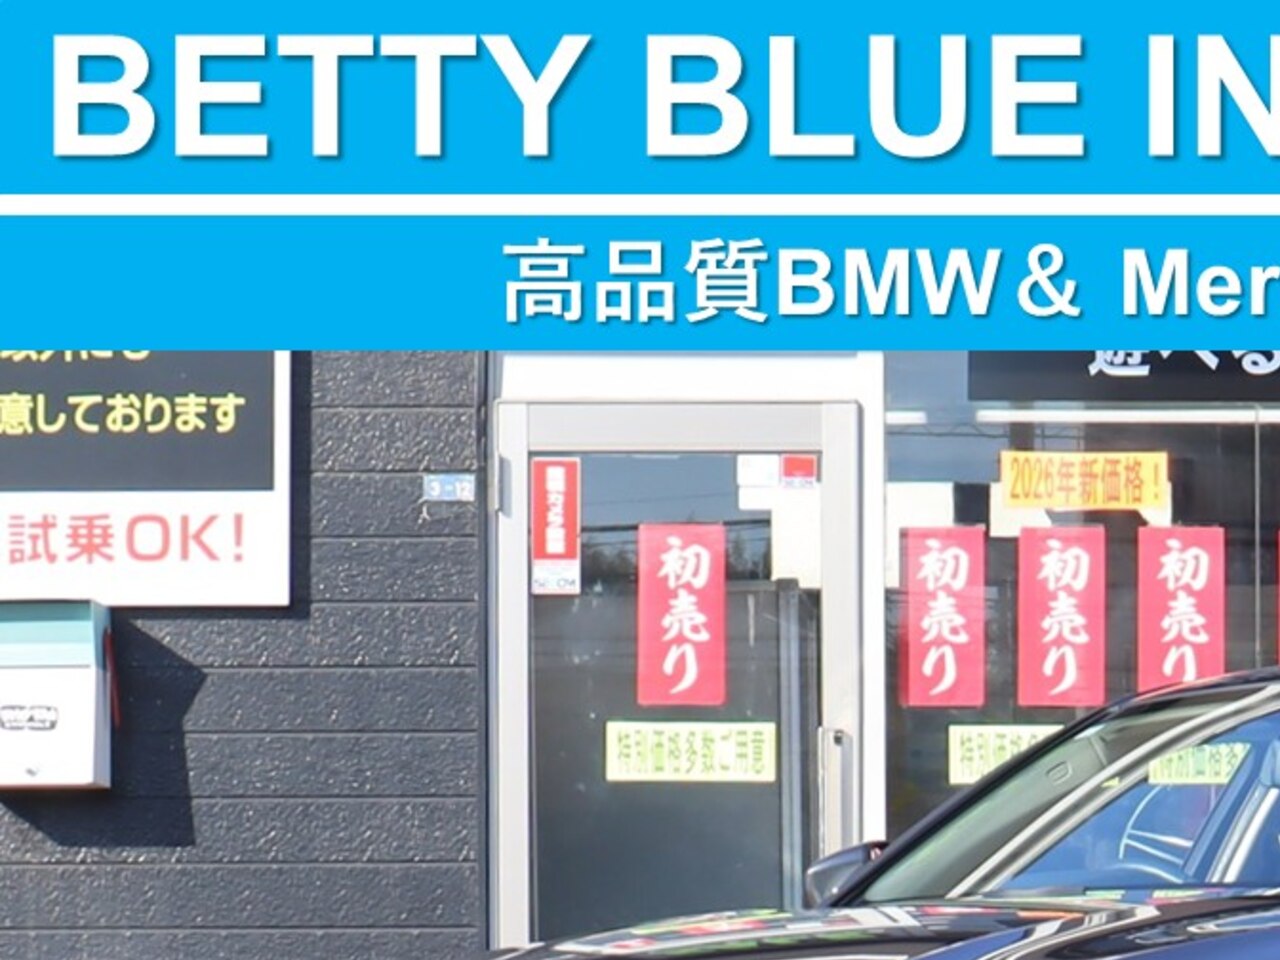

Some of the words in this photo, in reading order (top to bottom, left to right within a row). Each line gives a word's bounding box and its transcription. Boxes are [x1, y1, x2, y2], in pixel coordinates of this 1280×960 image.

[8, 512, 244, 565] 試乗OK!
[659, 536, 711, 694] 初売り
[916, 537, 969, 695] 初売り
[1038, 538, 1090, 695] 初売り
